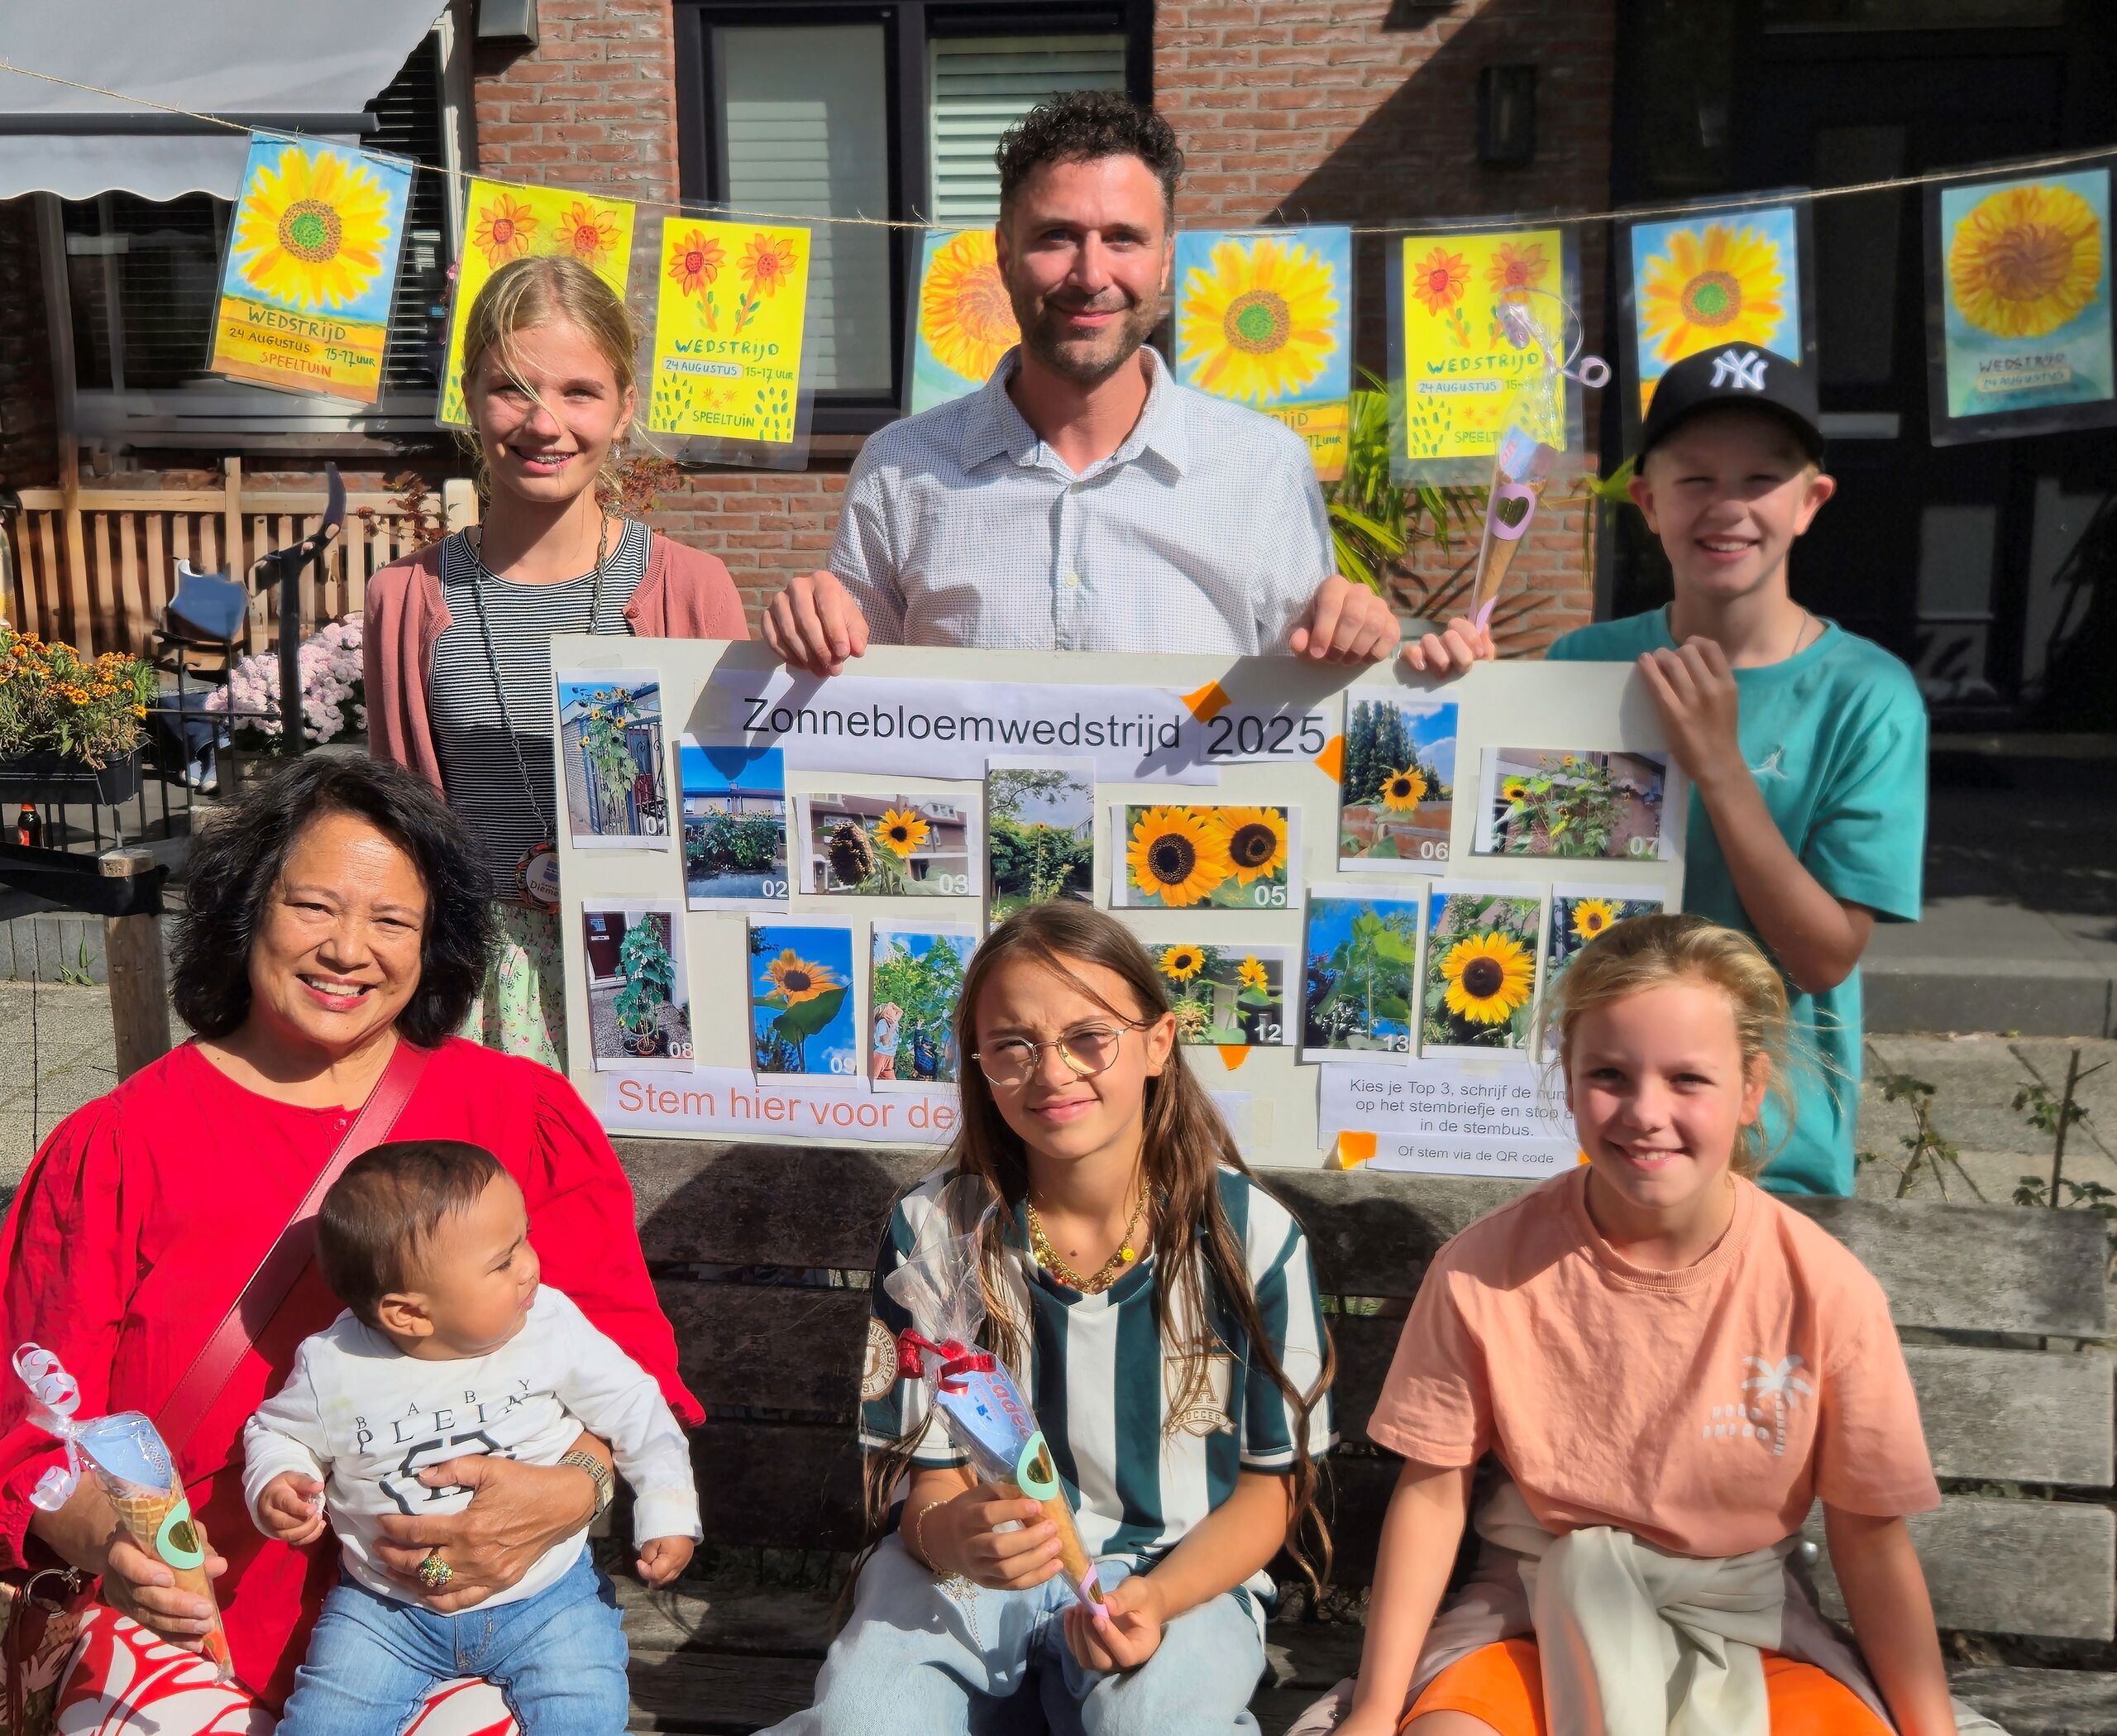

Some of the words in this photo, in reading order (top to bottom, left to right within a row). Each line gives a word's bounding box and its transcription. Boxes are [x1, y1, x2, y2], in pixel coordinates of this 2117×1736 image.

[229, 328, 245, 339] 24
[248, 332, 311, 353] AUGUSTUS
[324, 347, 356, 367] 15-17
[665, 359, 679, 371] 24
[681, 360, 738, 376] AUGUSTUS
[746, 366, 773, 384] 15-17
[1709, 349, 1769, 390] NY
[1418, 382, 1433, 393] 24
[1436, 381, 1498, 393] AUGUSTUS
[1455, 430, 1503, 443] SPEELT
[743, 698, 1180, 758] Zonnebloemwedstrijd
[1206, 715, 1326, 756] 2025
[644, 816, 668, 835] 01
[1419, 840, 1449, 860] 06
[1630, 836, 1659, 855] 07
[762, 879, 789, 898] 02
[939, 873, 969, 894] 03
[1254, 885, 1286, 906] 05
[1254, 1023, 1281, 1041] 12
[668, 1041, 693, 1059] 08
[1383, 1034, 1409, 1052] 13
[1350, 1078, 1383, 1093] Kies
[1387, 1080, 1402, 1096] je
[1407, 1080, 1436, 1098] Top
[1441, 1082, 1455, 1097] 3,
[1460, 1083, 1508, 1100] schrijf
[1511, 1086, 1531, 1098] de
[618, 1078, 716, 1117] Stem
[730, 1087, 803, 1122] hier
[809, 1100, 895, 1128] voor
[908, 1098, 955, 1130] de
[1355, 1100, 1375, 1113] op
[1379, 1098, 1404, 1112] het
[1409, 1100, 1495, 1119] stembriefje
[1500, 1106, 1520, 1117] en
[1526, 1106, 1559, 1121] stop
[1420, 1118, 1433, 1131] in
[1438, 1119, 1458, 1132] de
[1463, 1121, 1534, 1136] stembus.
[1398, 1145, 1415, 1156] Of
[1417, 1148, 1449, 1159] stem
[1453, 1149, 1471, 1160] via
[1477, 1149, 1493, 1160] de
[1496, 1150, 1518, 1163] QR
[1522, 1153, 1554, 1164] code
